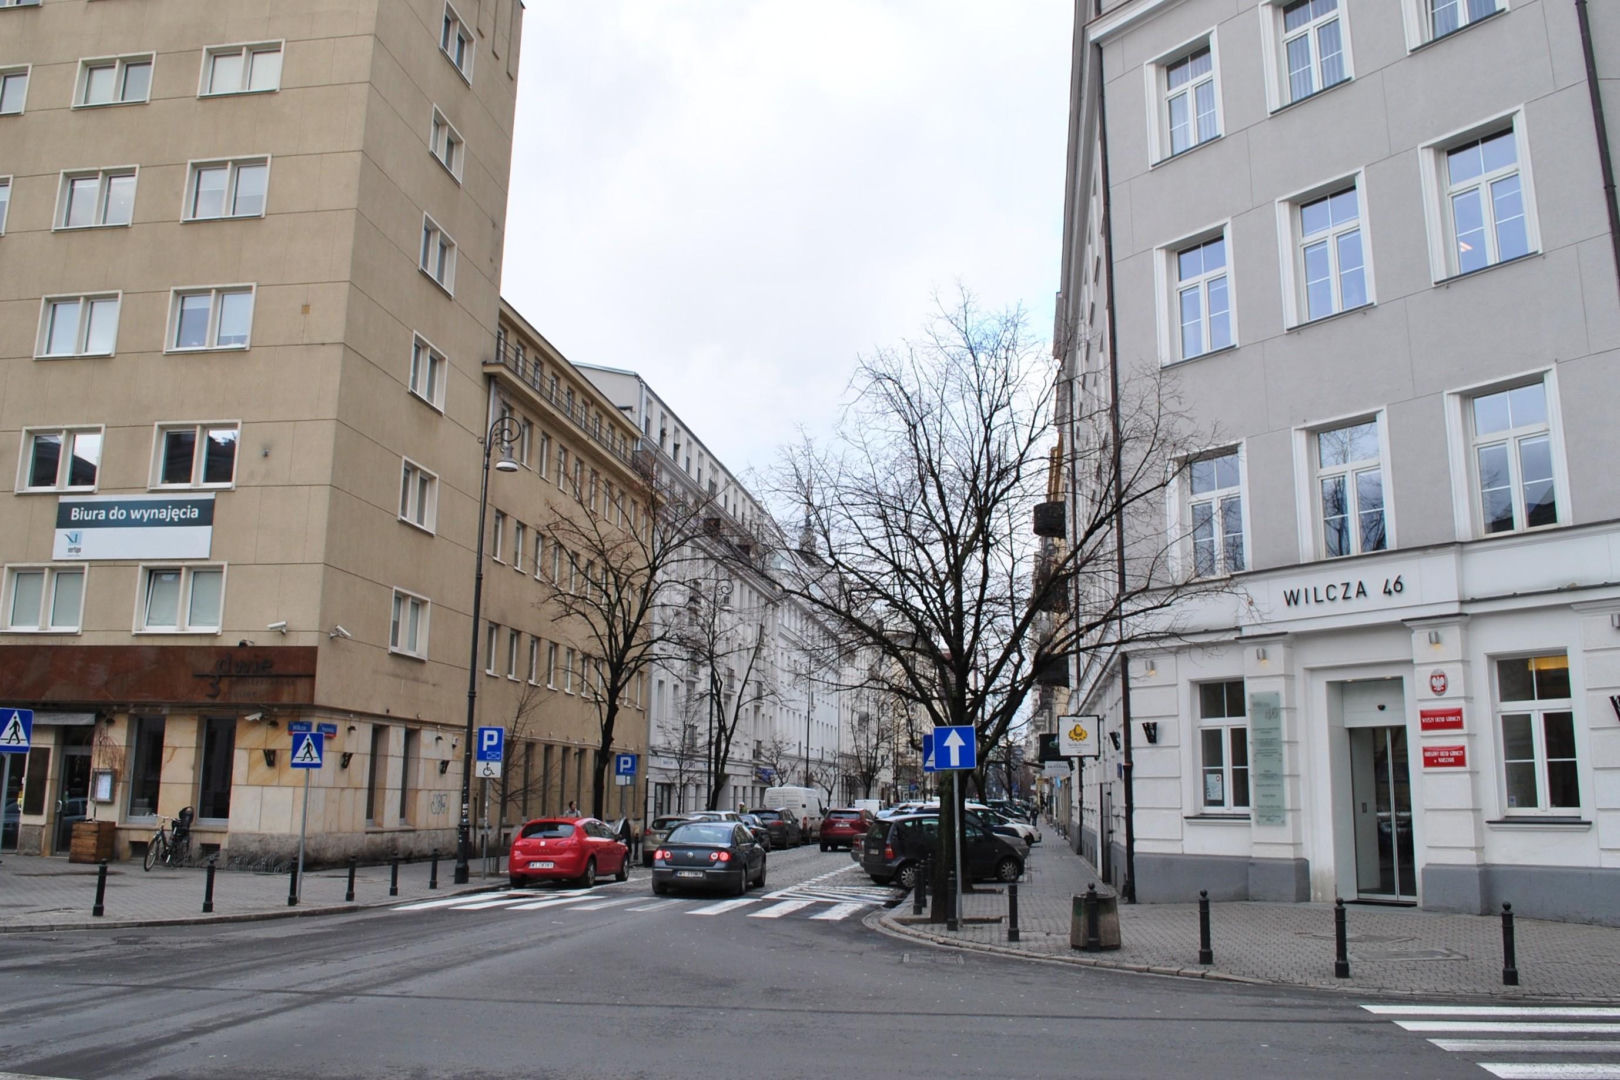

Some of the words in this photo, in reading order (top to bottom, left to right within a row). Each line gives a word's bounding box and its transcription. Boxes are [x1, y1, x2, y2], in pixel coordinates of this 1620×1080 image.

[70, 507, 106, 521] Biura
[108, 506, 127, 520] do
[130, 505, 199, 522] wynajęcia
[1283, 580, 1367, 607] WILCZA
[1383, 574, 1403, 596] 46
[482, 730, 498, 751] P
[620, 756, 631, 773] P
